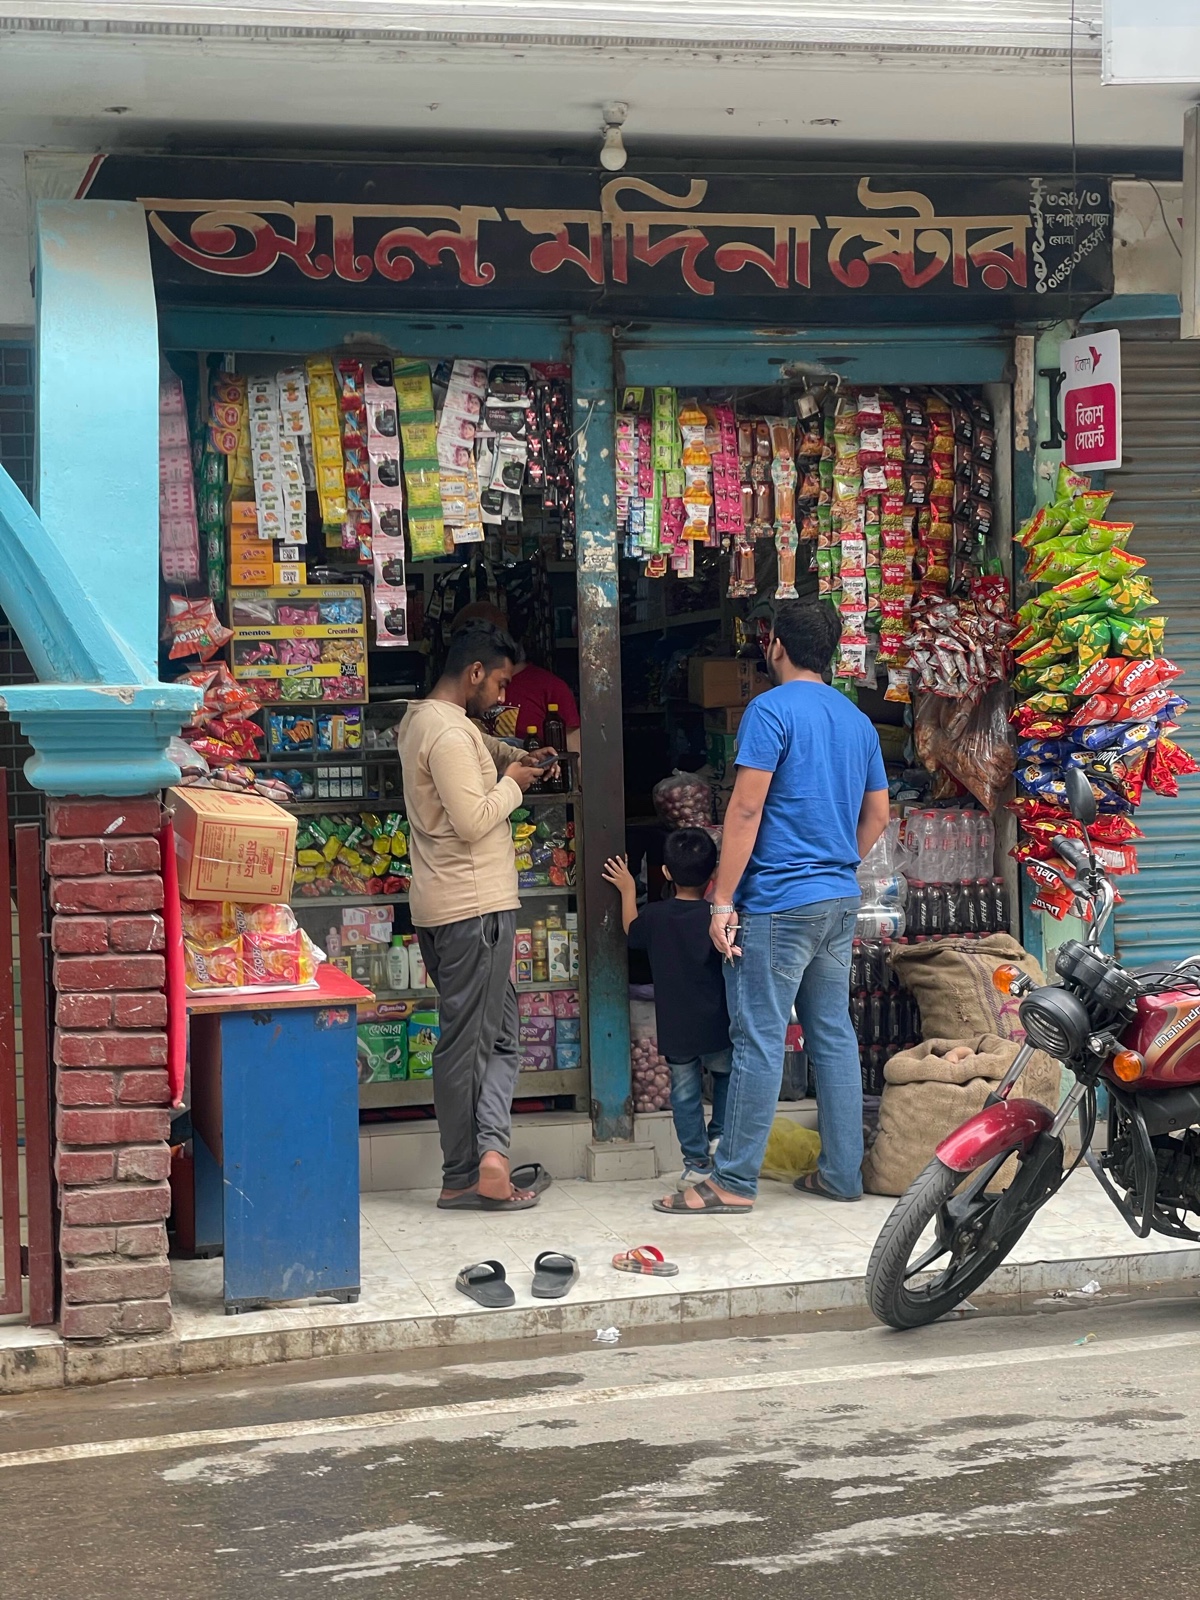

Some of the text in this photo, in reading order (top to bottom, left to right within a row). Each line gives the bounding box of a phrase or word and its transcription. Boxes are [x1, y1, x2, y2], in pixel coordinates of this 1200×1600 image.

[504, 176, 820, 296] মদিনা
[825, 176, 1031, 289] ষ্টোর
[1076, 403, 1104, 427] বিকাশ
[1075, 425, 1105, 450] পেমেন্ট
[239, 629, 271, 637] mentos
[1124, 659, 1154, 688] Detos
[1131, 690, 1166, 711] Detos
[1128, 725, 1150, 738] Sun
